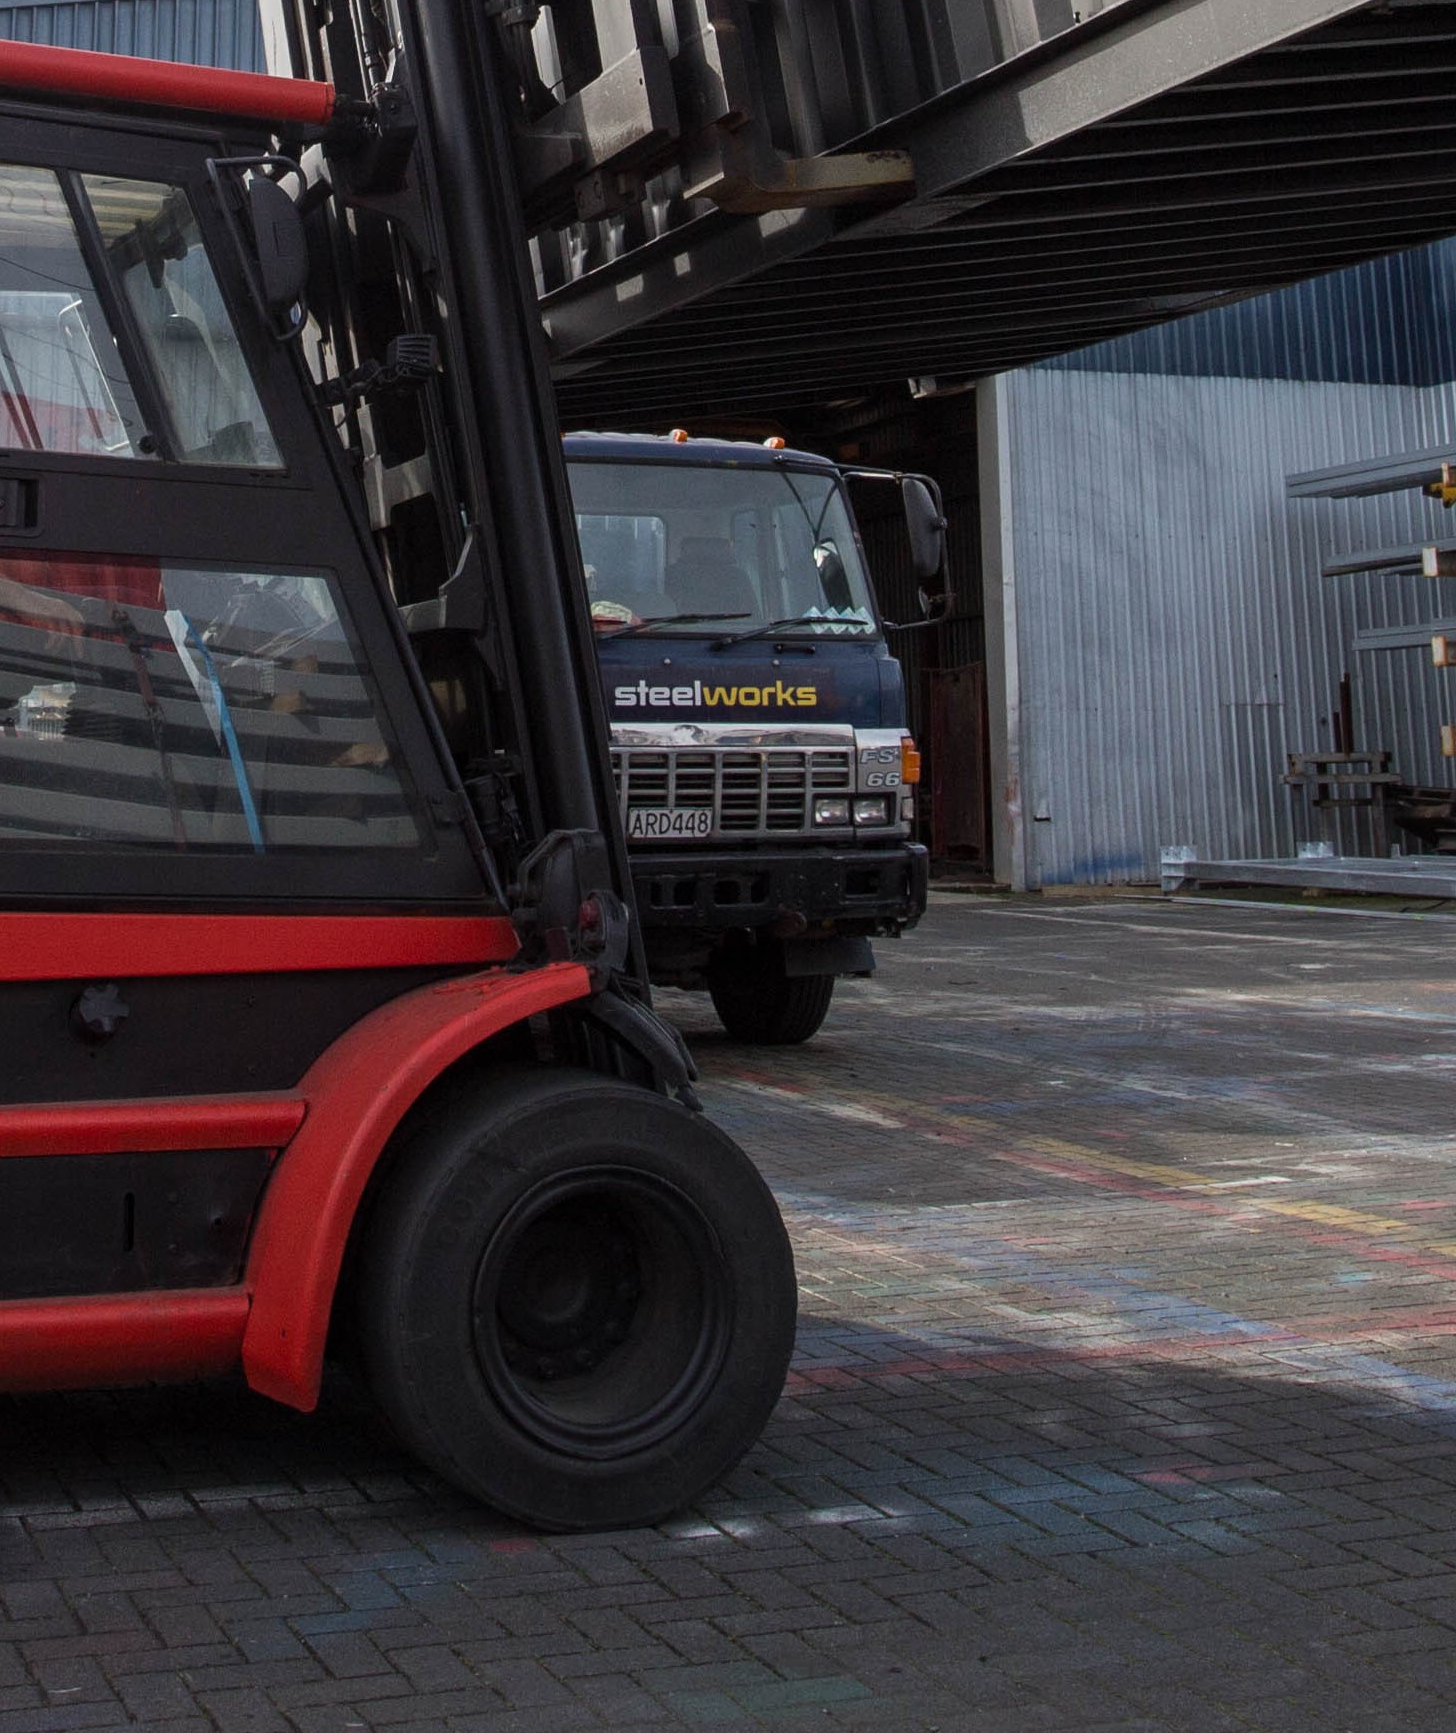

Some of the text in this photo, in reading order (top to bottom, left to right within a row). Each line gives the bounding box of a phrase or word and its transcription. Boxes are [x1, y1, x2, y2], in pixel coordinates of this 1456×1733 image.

[615, 680, 817, 707] steelworks
[866, 771, 900, 787] 66
[632, 810, 709, 836] ARD448
